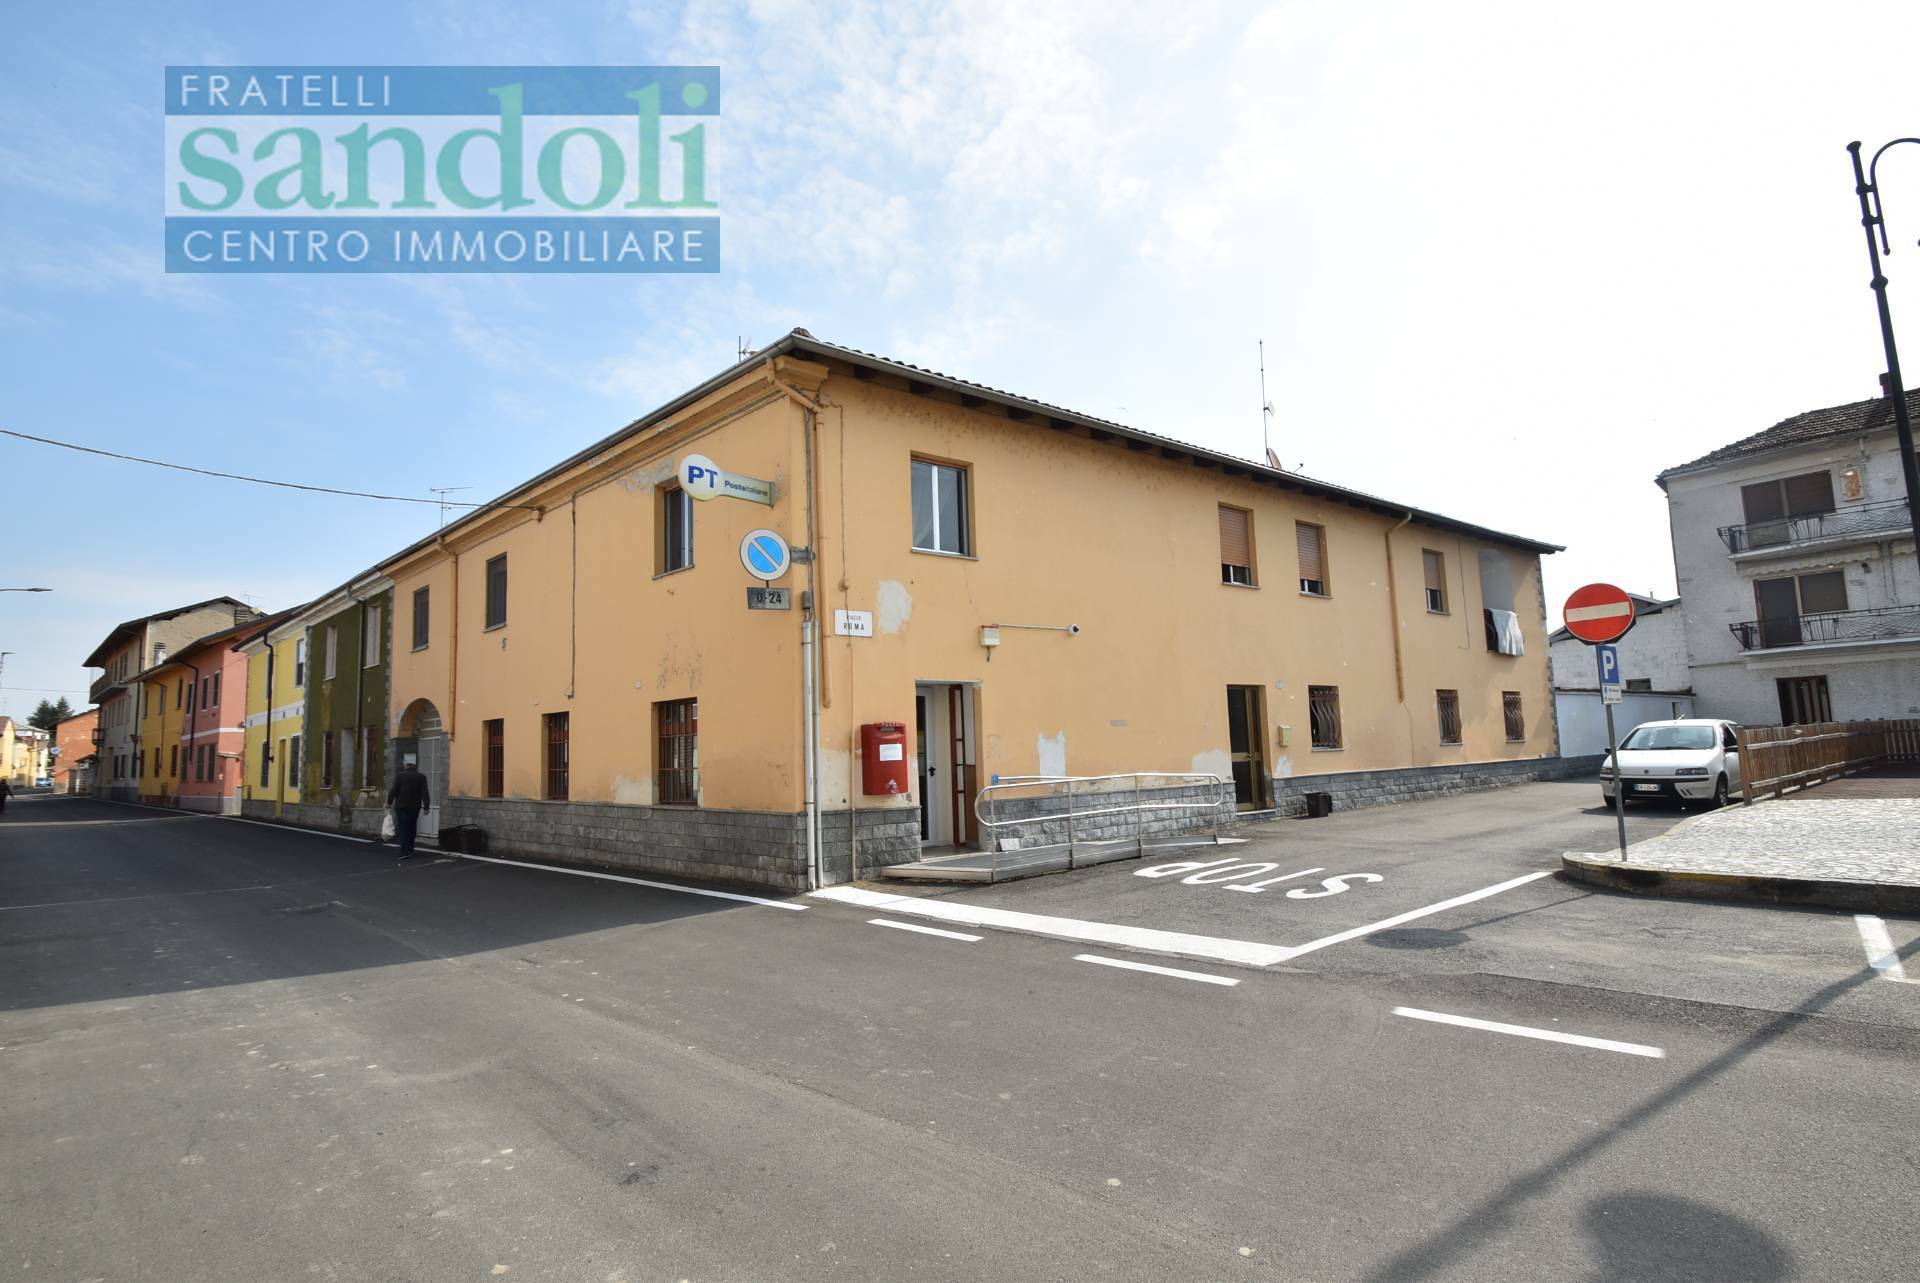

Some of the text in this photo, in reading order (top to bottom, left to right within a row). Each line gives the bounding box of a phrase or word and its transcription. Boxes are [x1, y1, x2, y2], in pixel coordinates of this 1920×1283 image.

[688, 465, 718, 488] PT
[843, 622, 865, 631] ROMA
[1602, 650, 1614, 680] P
[1133, 858, 1384, 899] STOP
